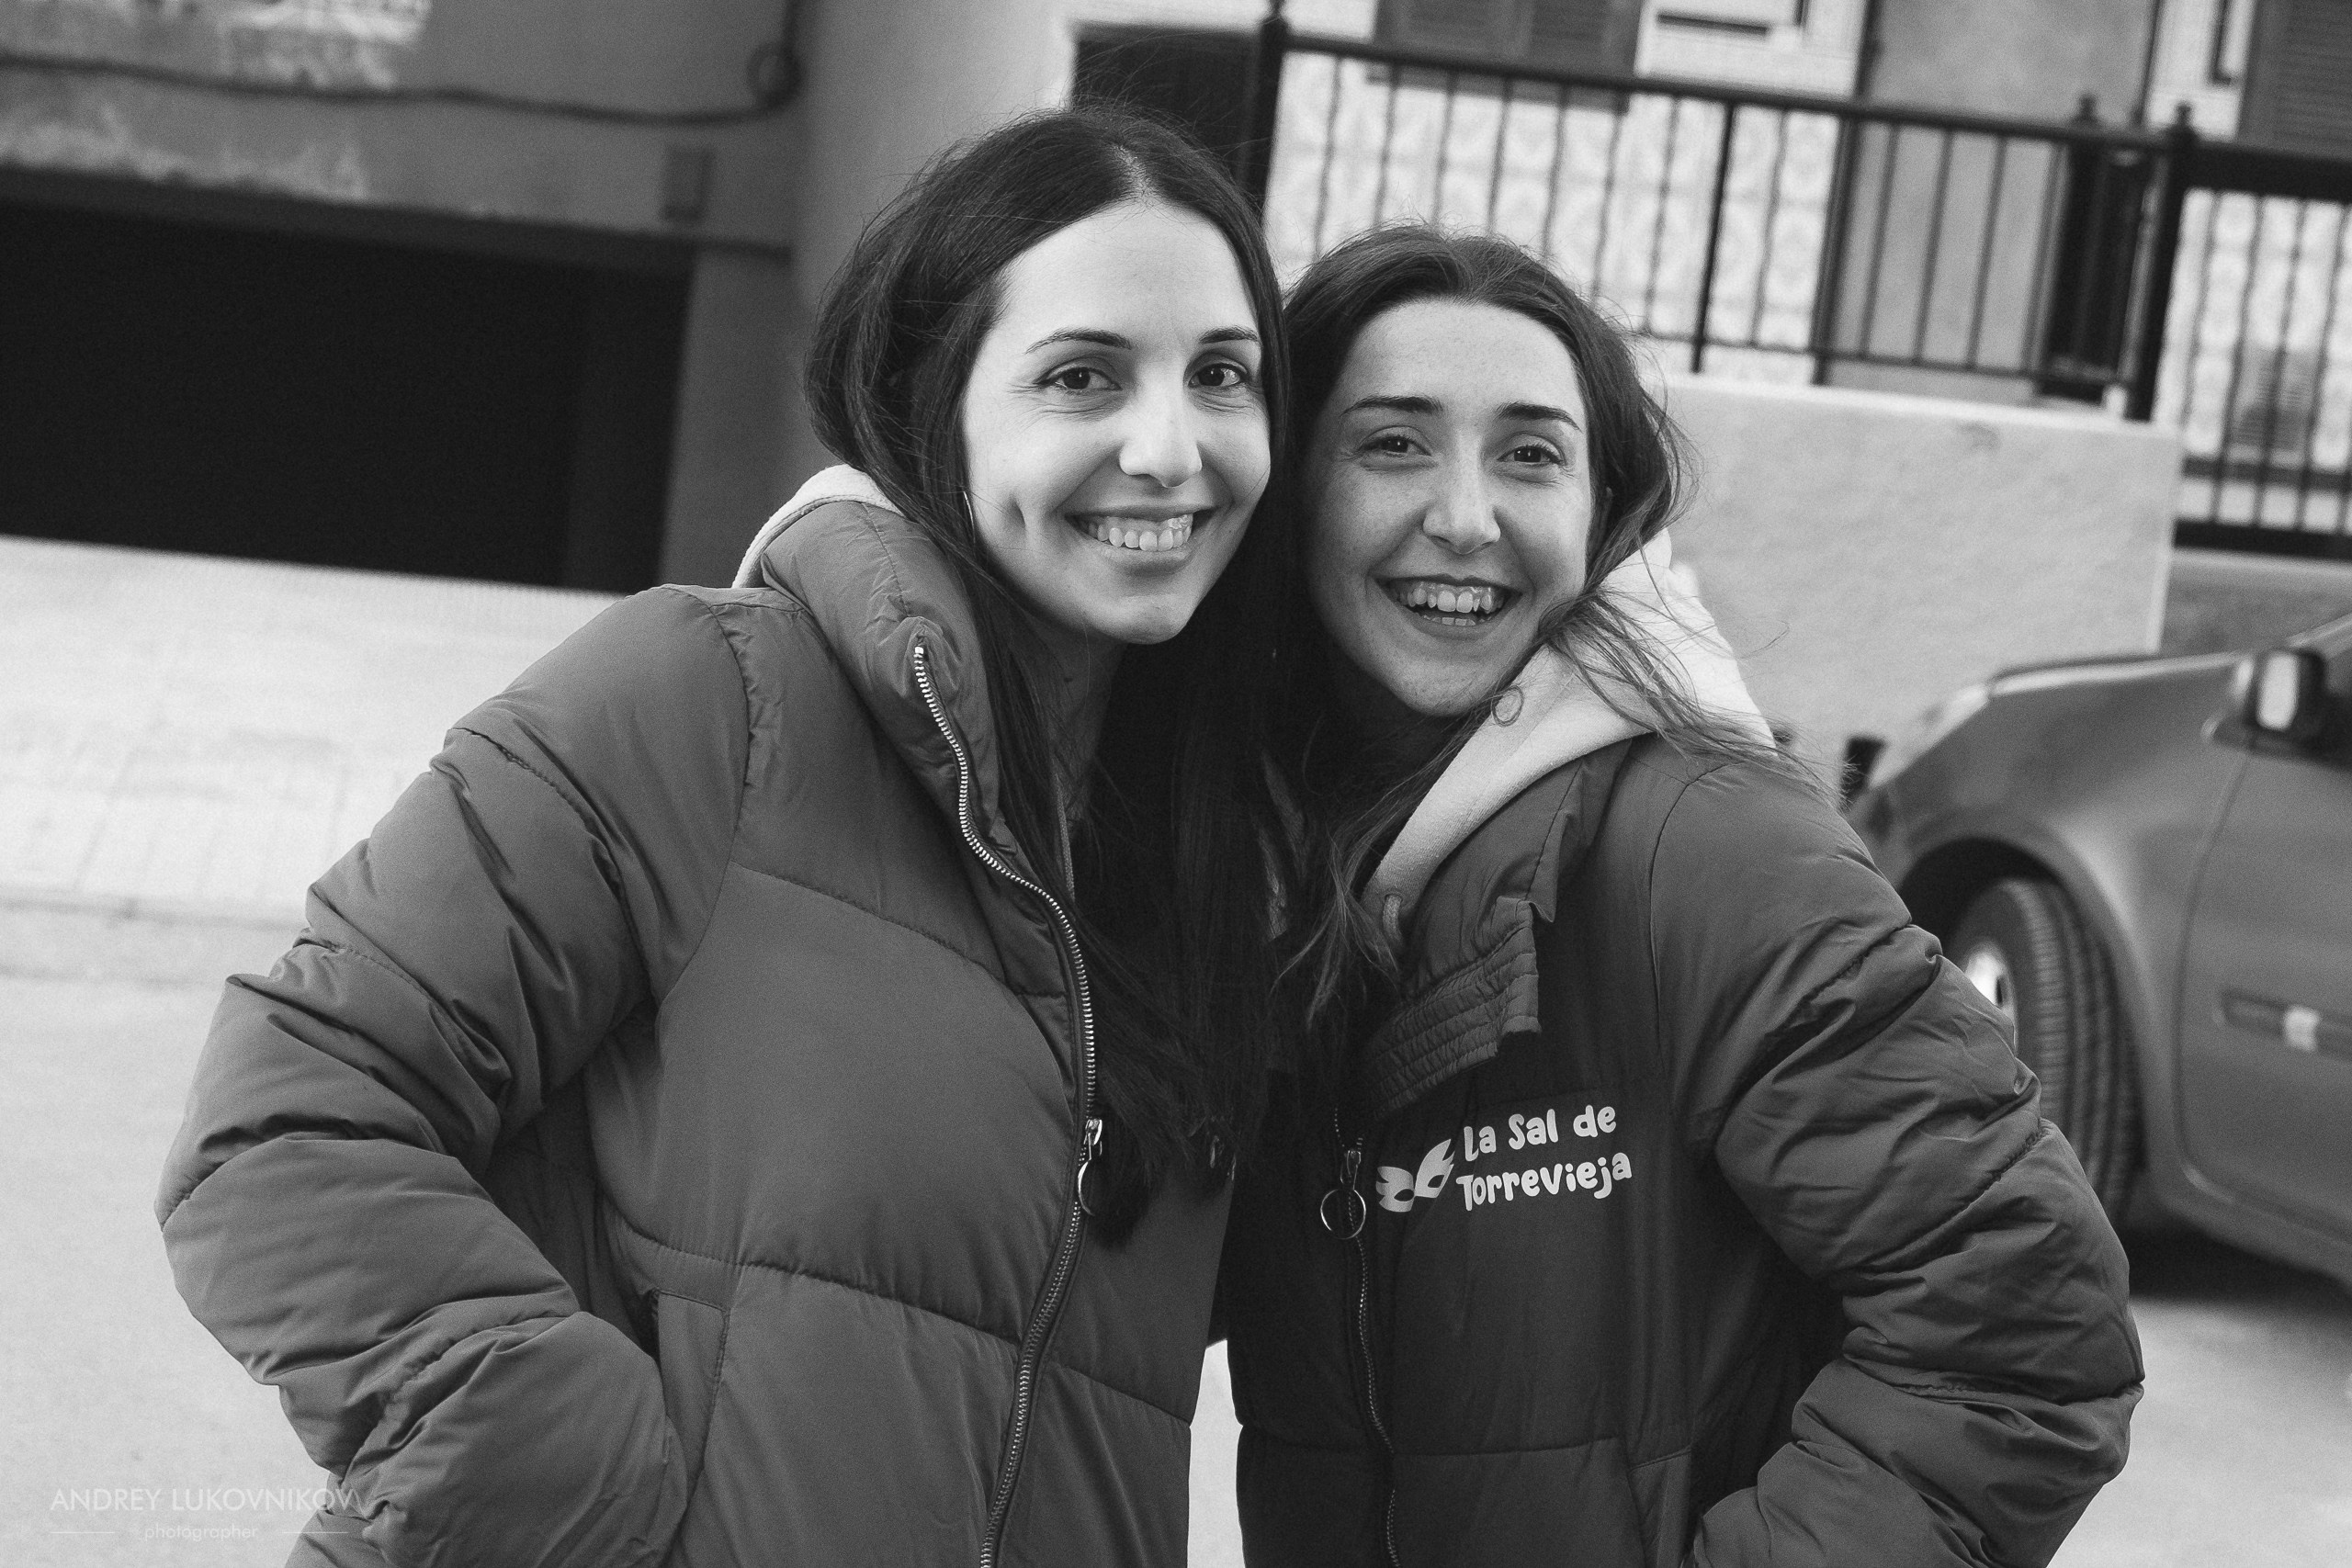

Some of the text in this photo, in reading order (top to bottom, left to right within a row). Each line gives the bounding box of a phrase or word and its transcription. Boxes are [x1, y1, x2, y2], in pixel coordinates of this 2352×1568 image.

[1464, 1104, 1617, 1162] La Sal de
[1455, 1152, 1633, 1212] Torrevieja
